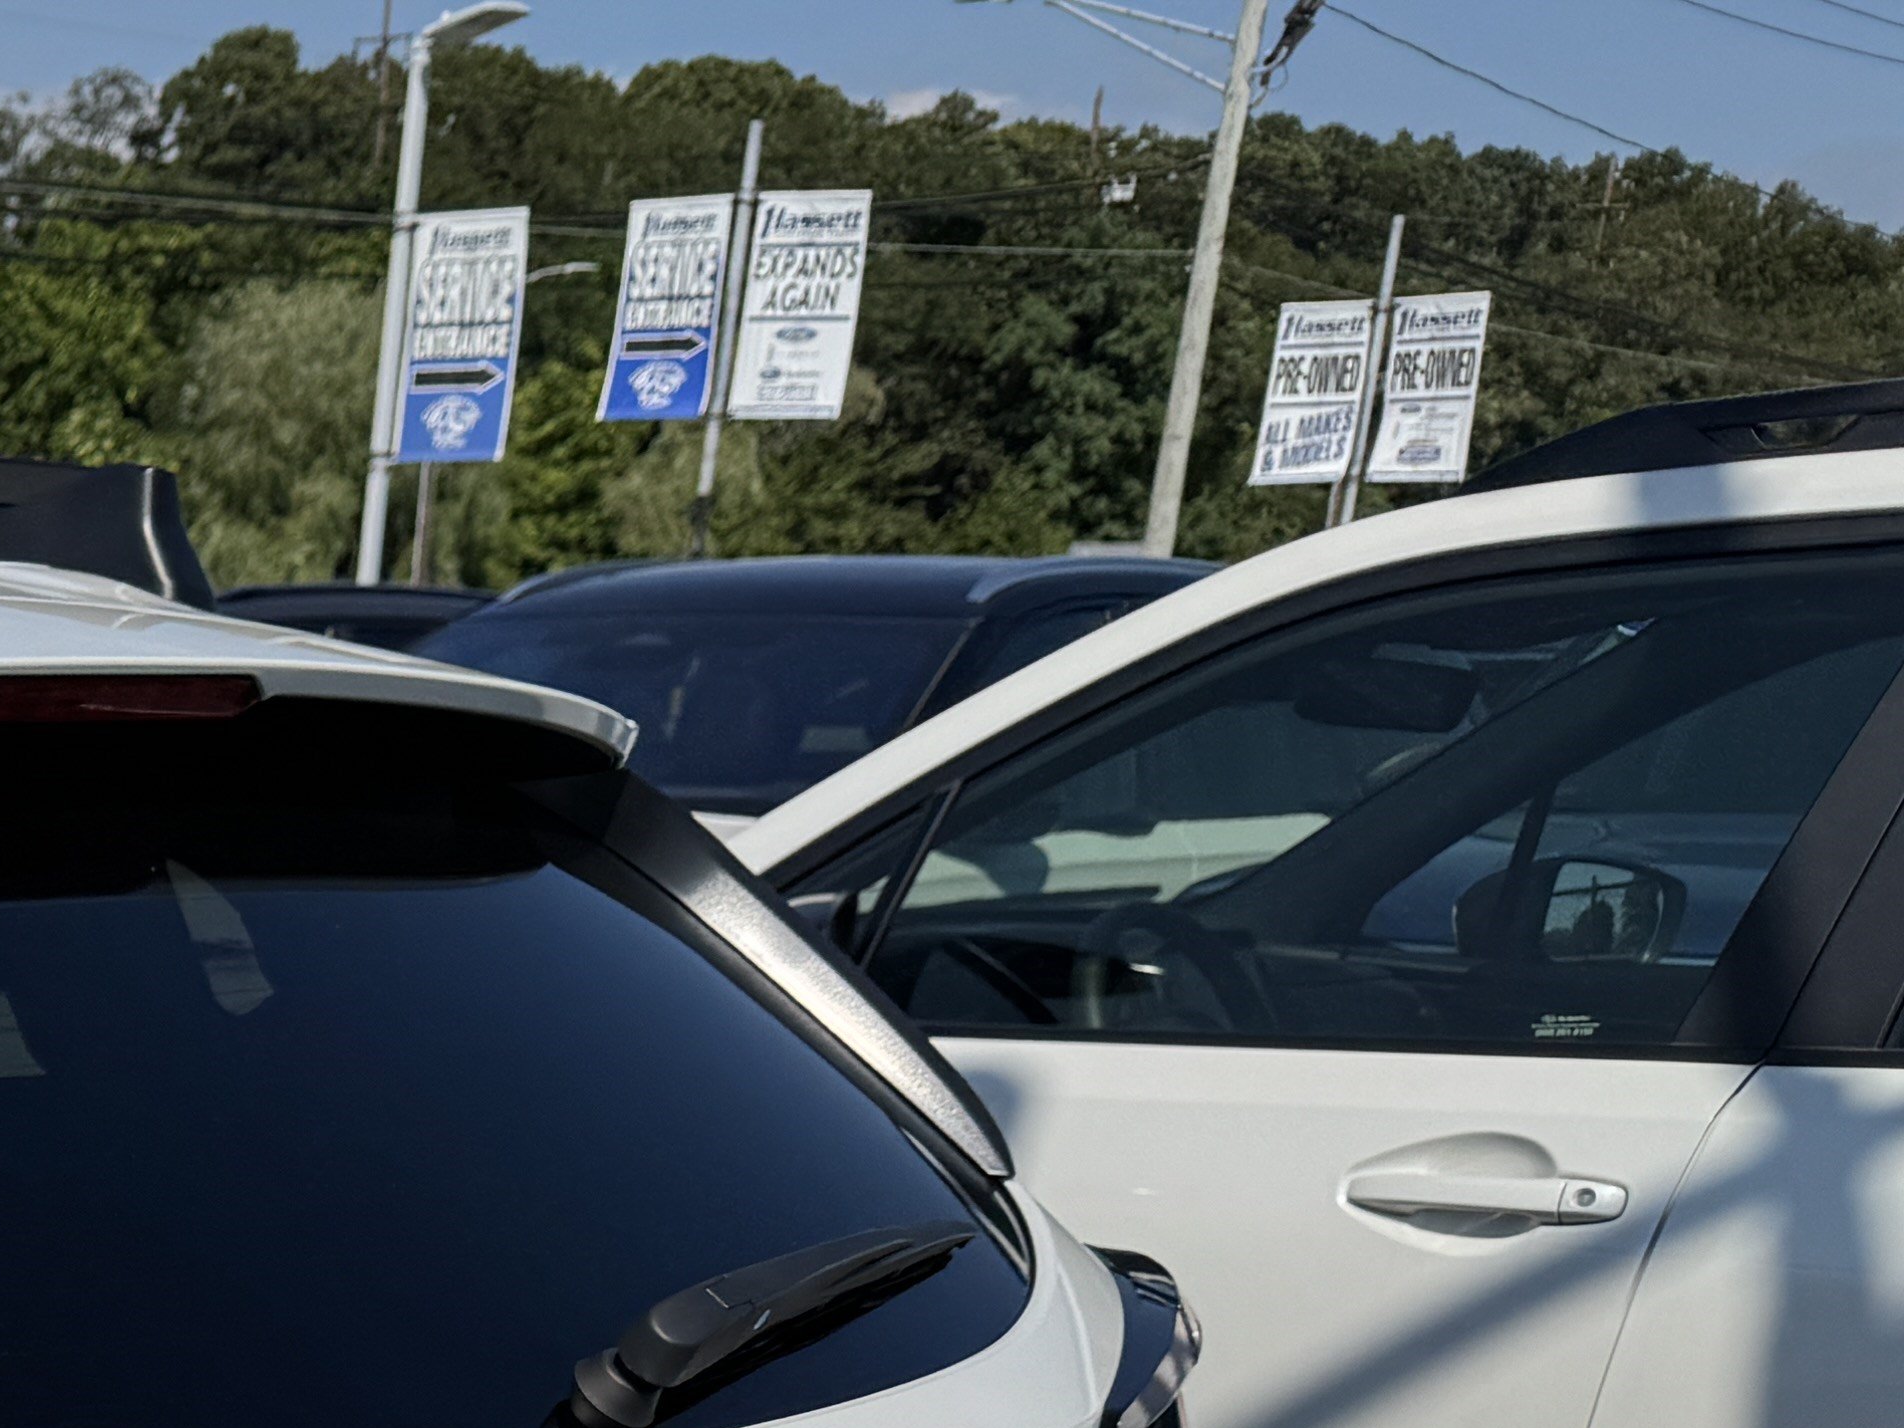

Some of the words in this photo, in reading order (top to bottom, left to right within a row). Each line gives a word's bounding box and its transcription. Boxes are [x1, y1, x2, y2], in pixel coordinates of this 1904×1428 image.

[629, 237, 721, 299] SERVICE
[753, 247, 860, 280] EXPANDS
[414, 255, 516, 325] SERVICE
[759, 281, 842, 312] AGAIN
[1270, 353, 1361, 396] PRE-OWNED
[1391, 346, 1477, 391] PRE-OWNED
[1265, 419, 1291, 444] ALL
[1294, 403, 1354, 440] MAKES
